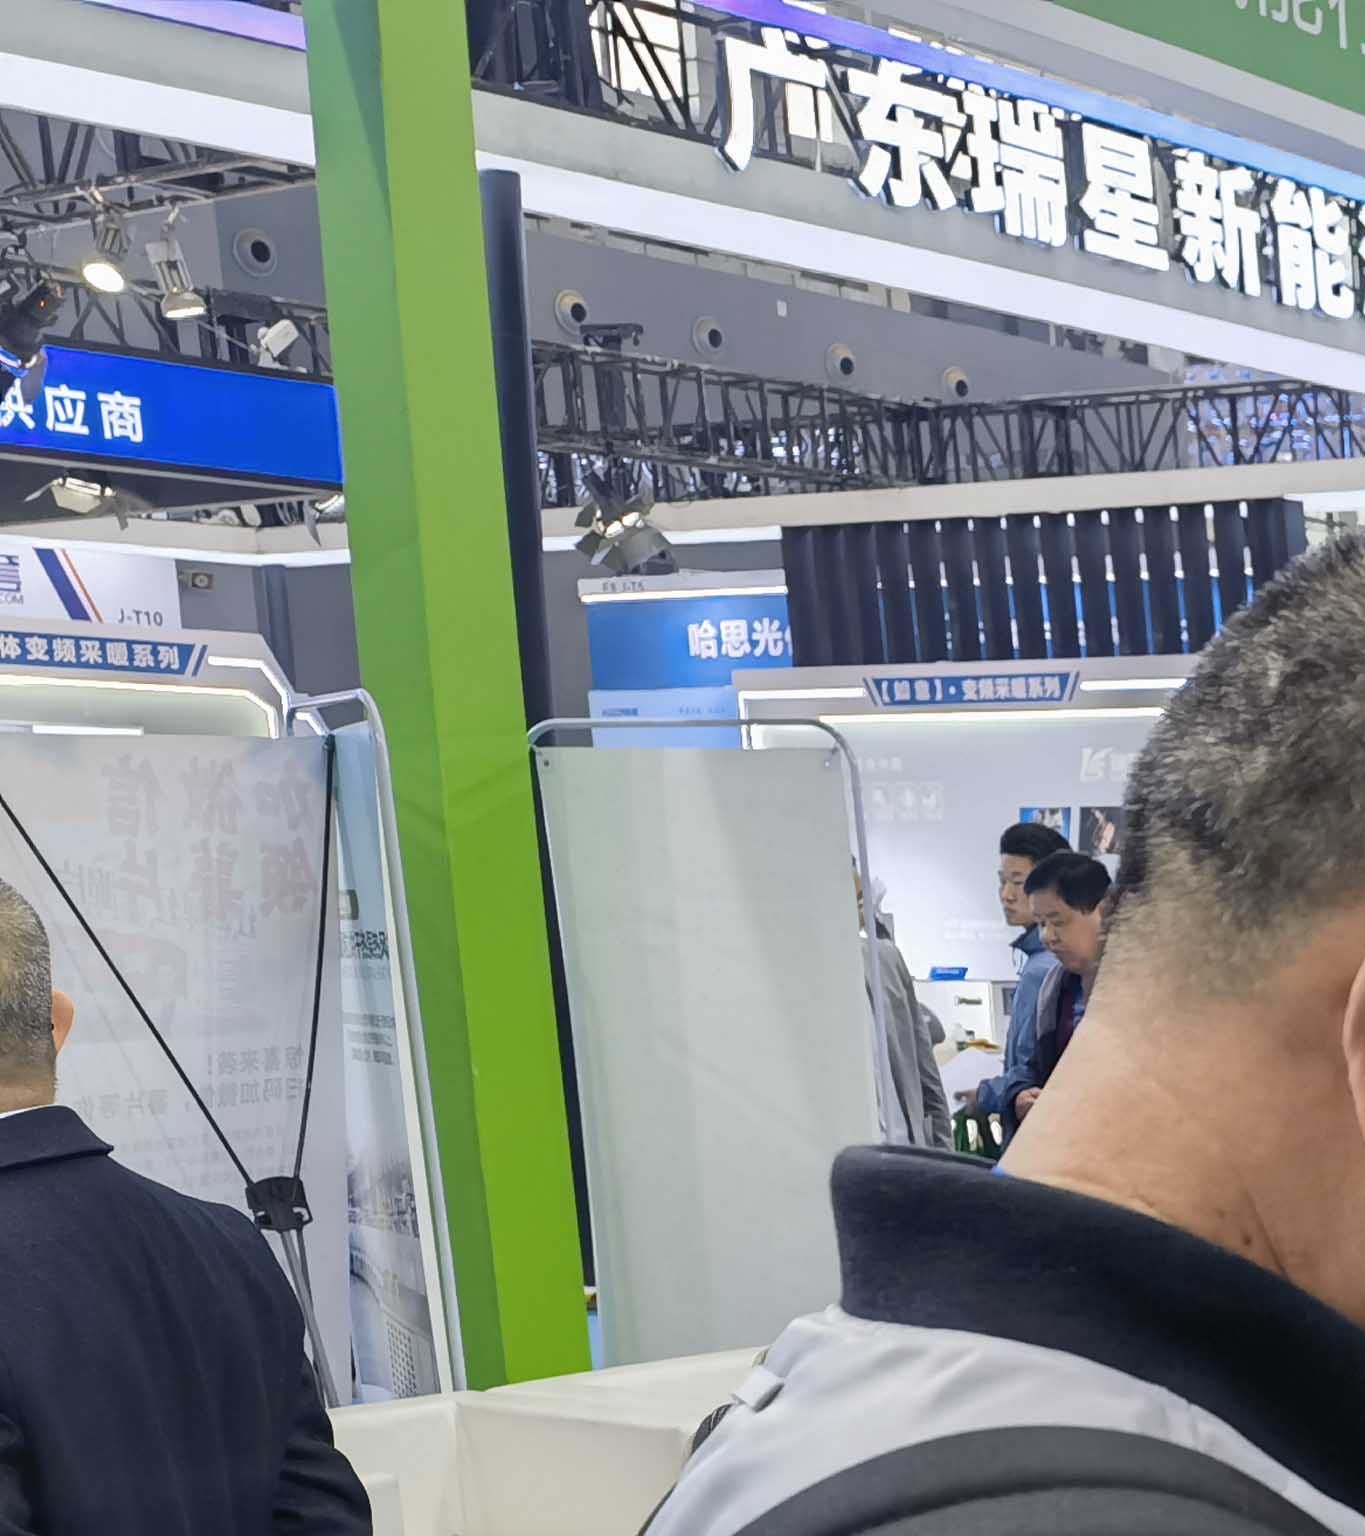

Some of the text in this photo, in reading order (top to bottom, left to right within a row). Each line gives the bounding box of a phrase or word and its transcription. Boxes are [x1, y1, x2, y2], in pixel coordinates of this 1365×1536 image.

[118, 608, 163, 626] J-T10
[687, 617, 793, 659] 哈思光
